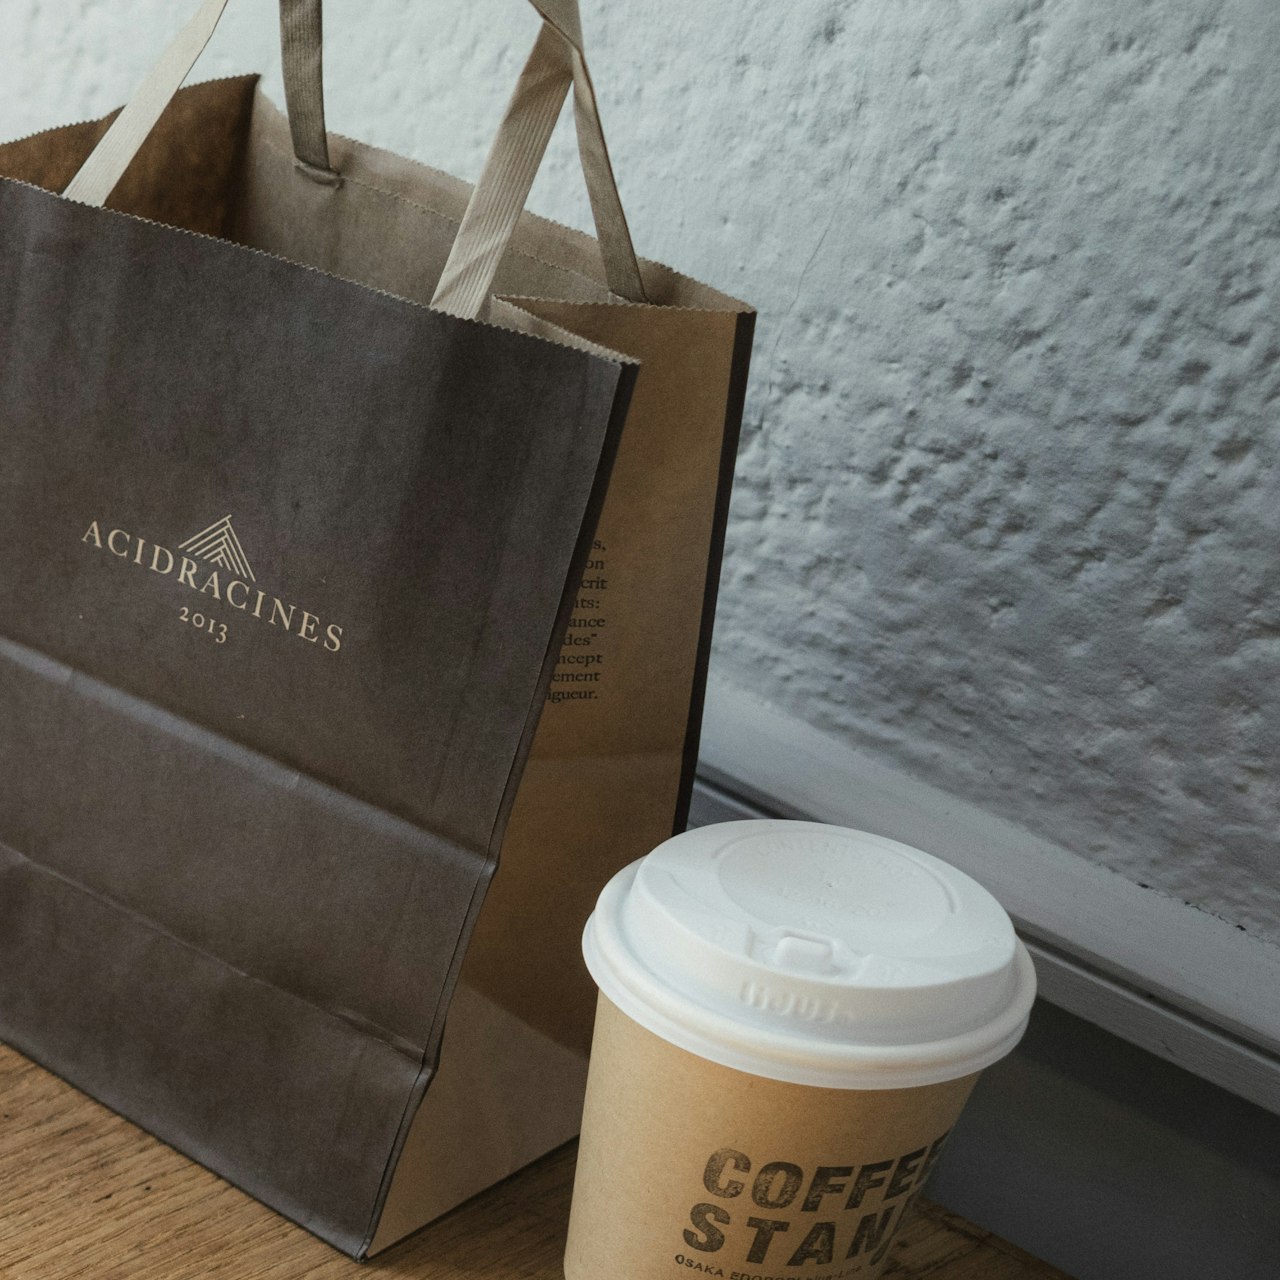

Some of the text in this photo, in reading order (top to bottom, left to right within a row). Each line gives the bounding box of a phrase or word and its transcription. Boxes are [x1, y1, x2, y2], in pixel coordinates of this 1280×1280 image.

[81, 520, 344, 652] ACIDRACINES
[179, 606, 228, 644] 2013
[674, 1253, 724, 1278] OSAKA
